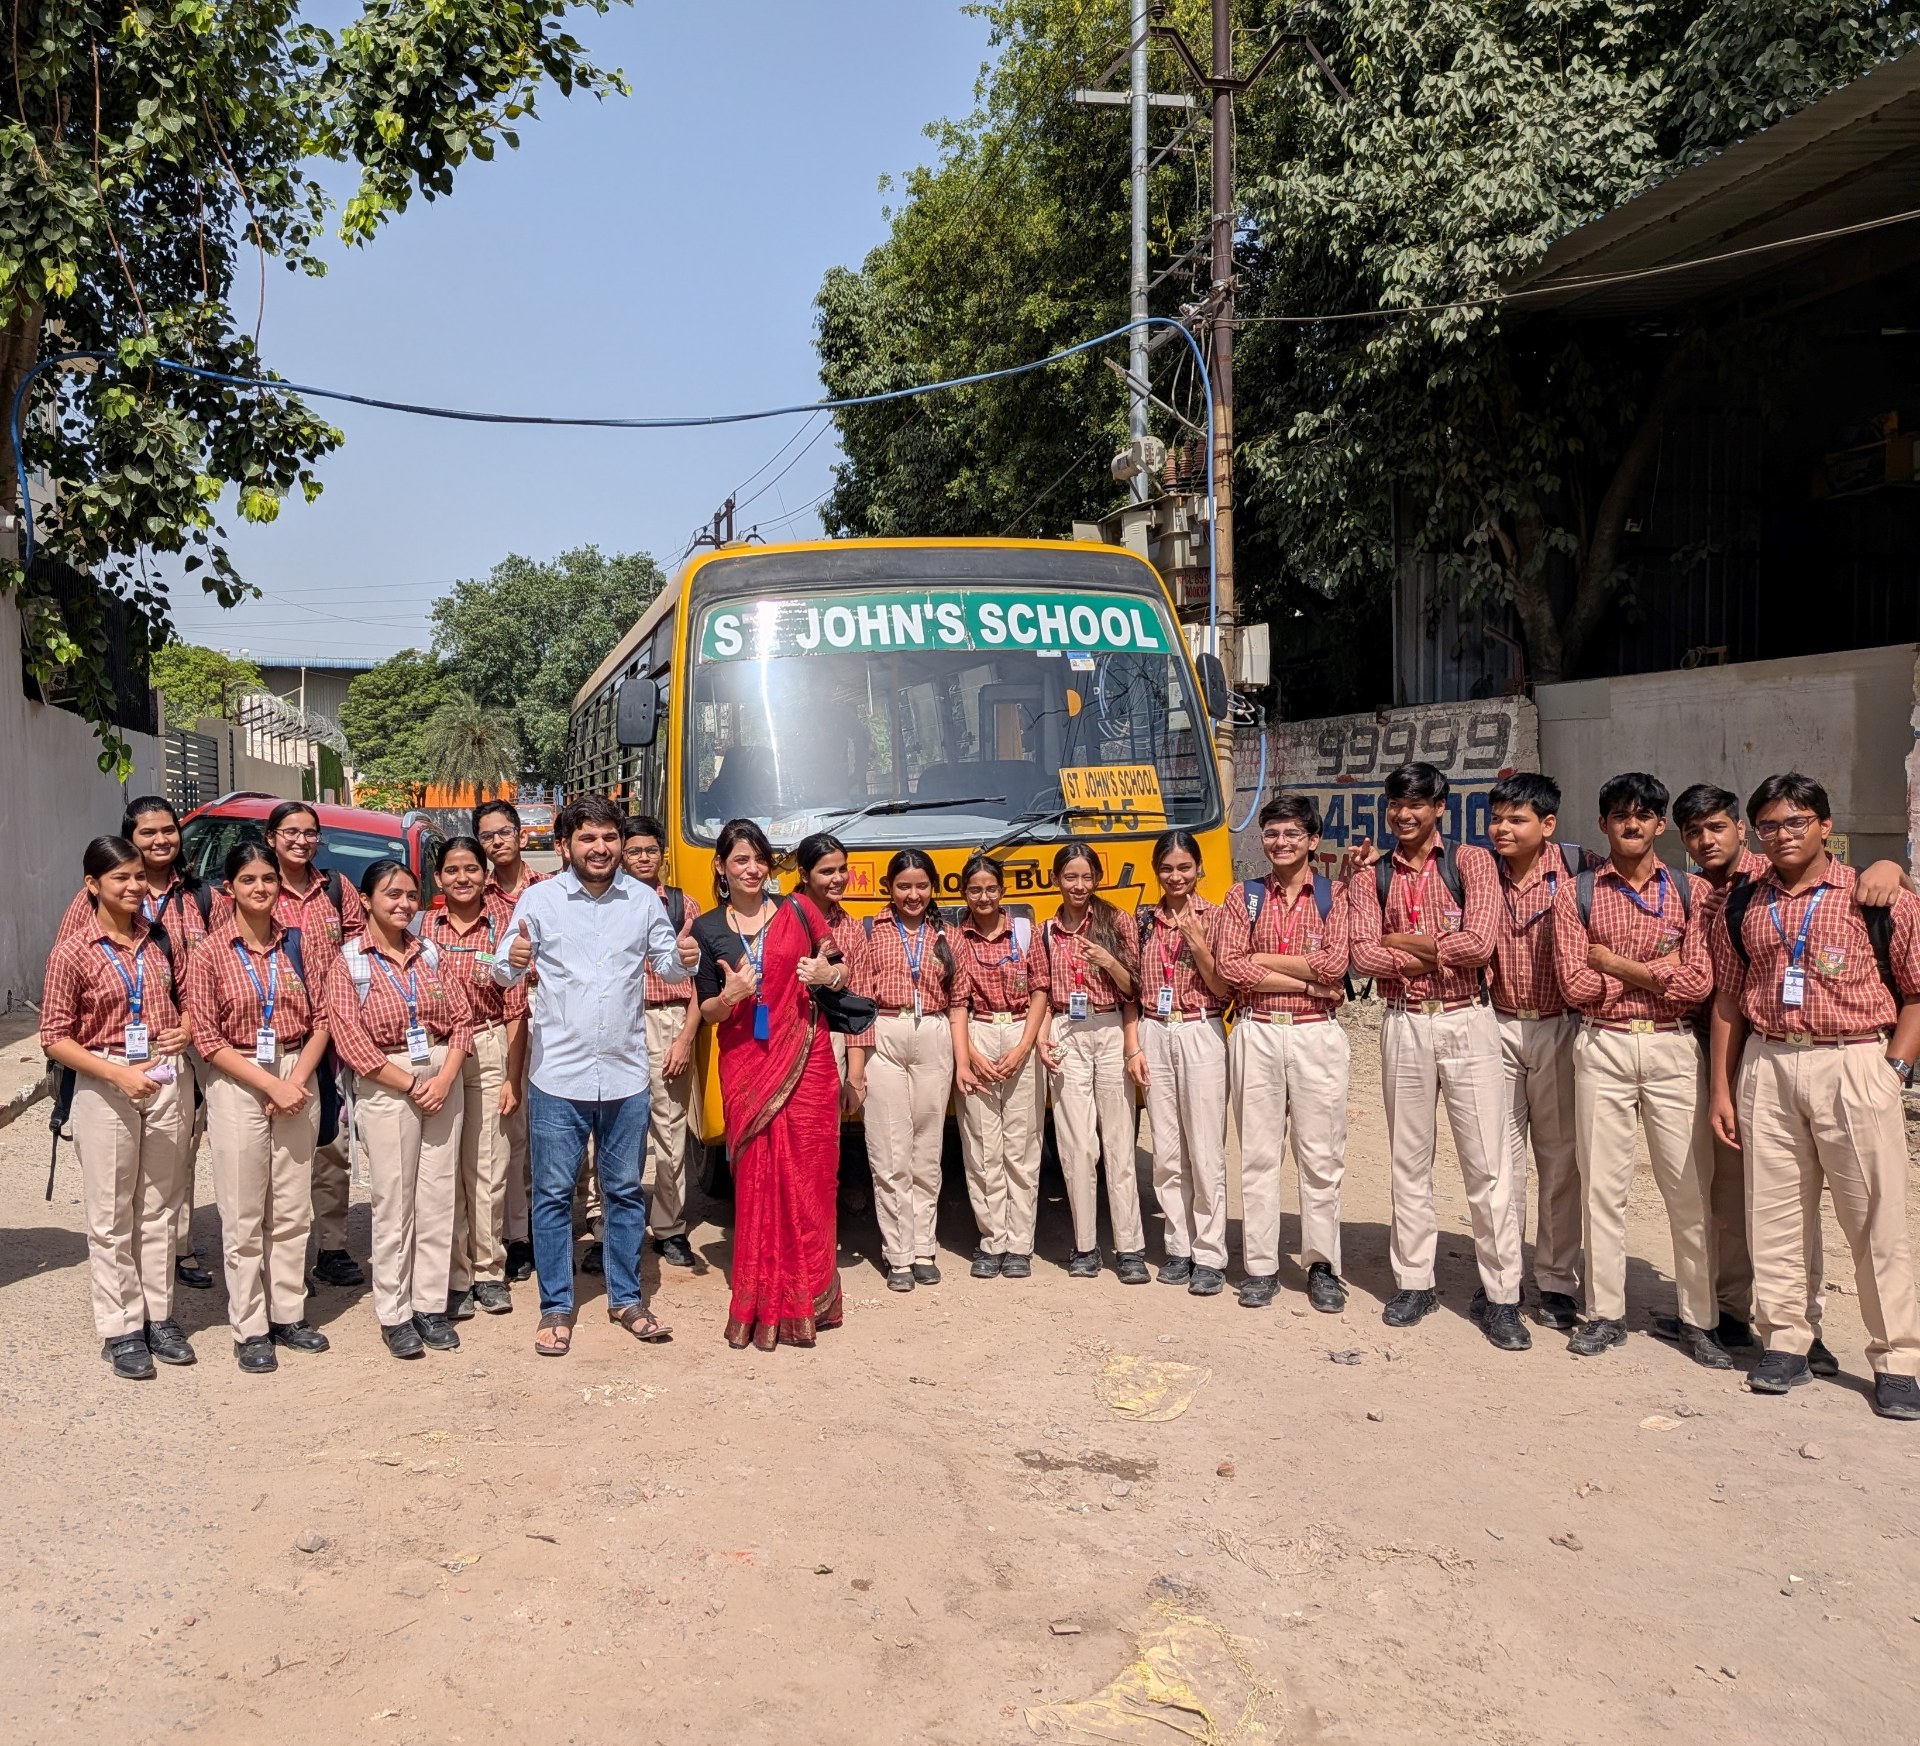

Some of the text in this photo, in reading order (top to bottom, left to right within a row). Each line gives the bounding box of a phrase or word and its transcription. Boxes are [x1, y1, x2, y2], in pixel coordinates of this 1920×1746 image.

[796, 603, 965, 649] JOHN'S
[978, 603, 1159, 648] SCHOOL
[1067, 769, 1158, 798] ST JOHN'S SCHOOL
[1015, 869, 1053, 890] BU
[1247, 893, 1259, 922] safari
